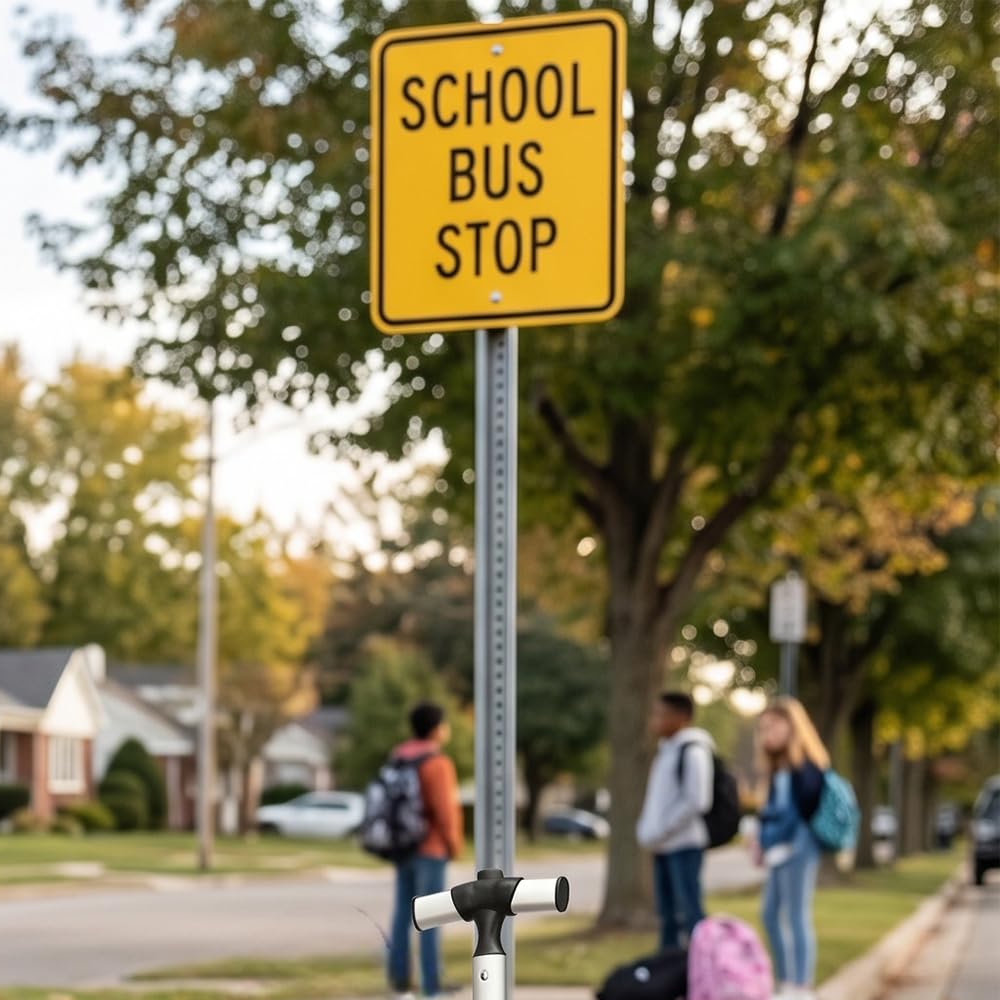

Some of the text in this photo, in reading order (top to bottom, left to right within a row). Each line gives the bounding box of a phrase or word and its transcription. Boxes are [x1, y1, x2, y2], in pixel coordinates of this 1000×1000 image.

[401, 62, 595, 131] SCHOOL
[450, 141, 543, 203] BUS
[435, 217, 557, 279] STOP
